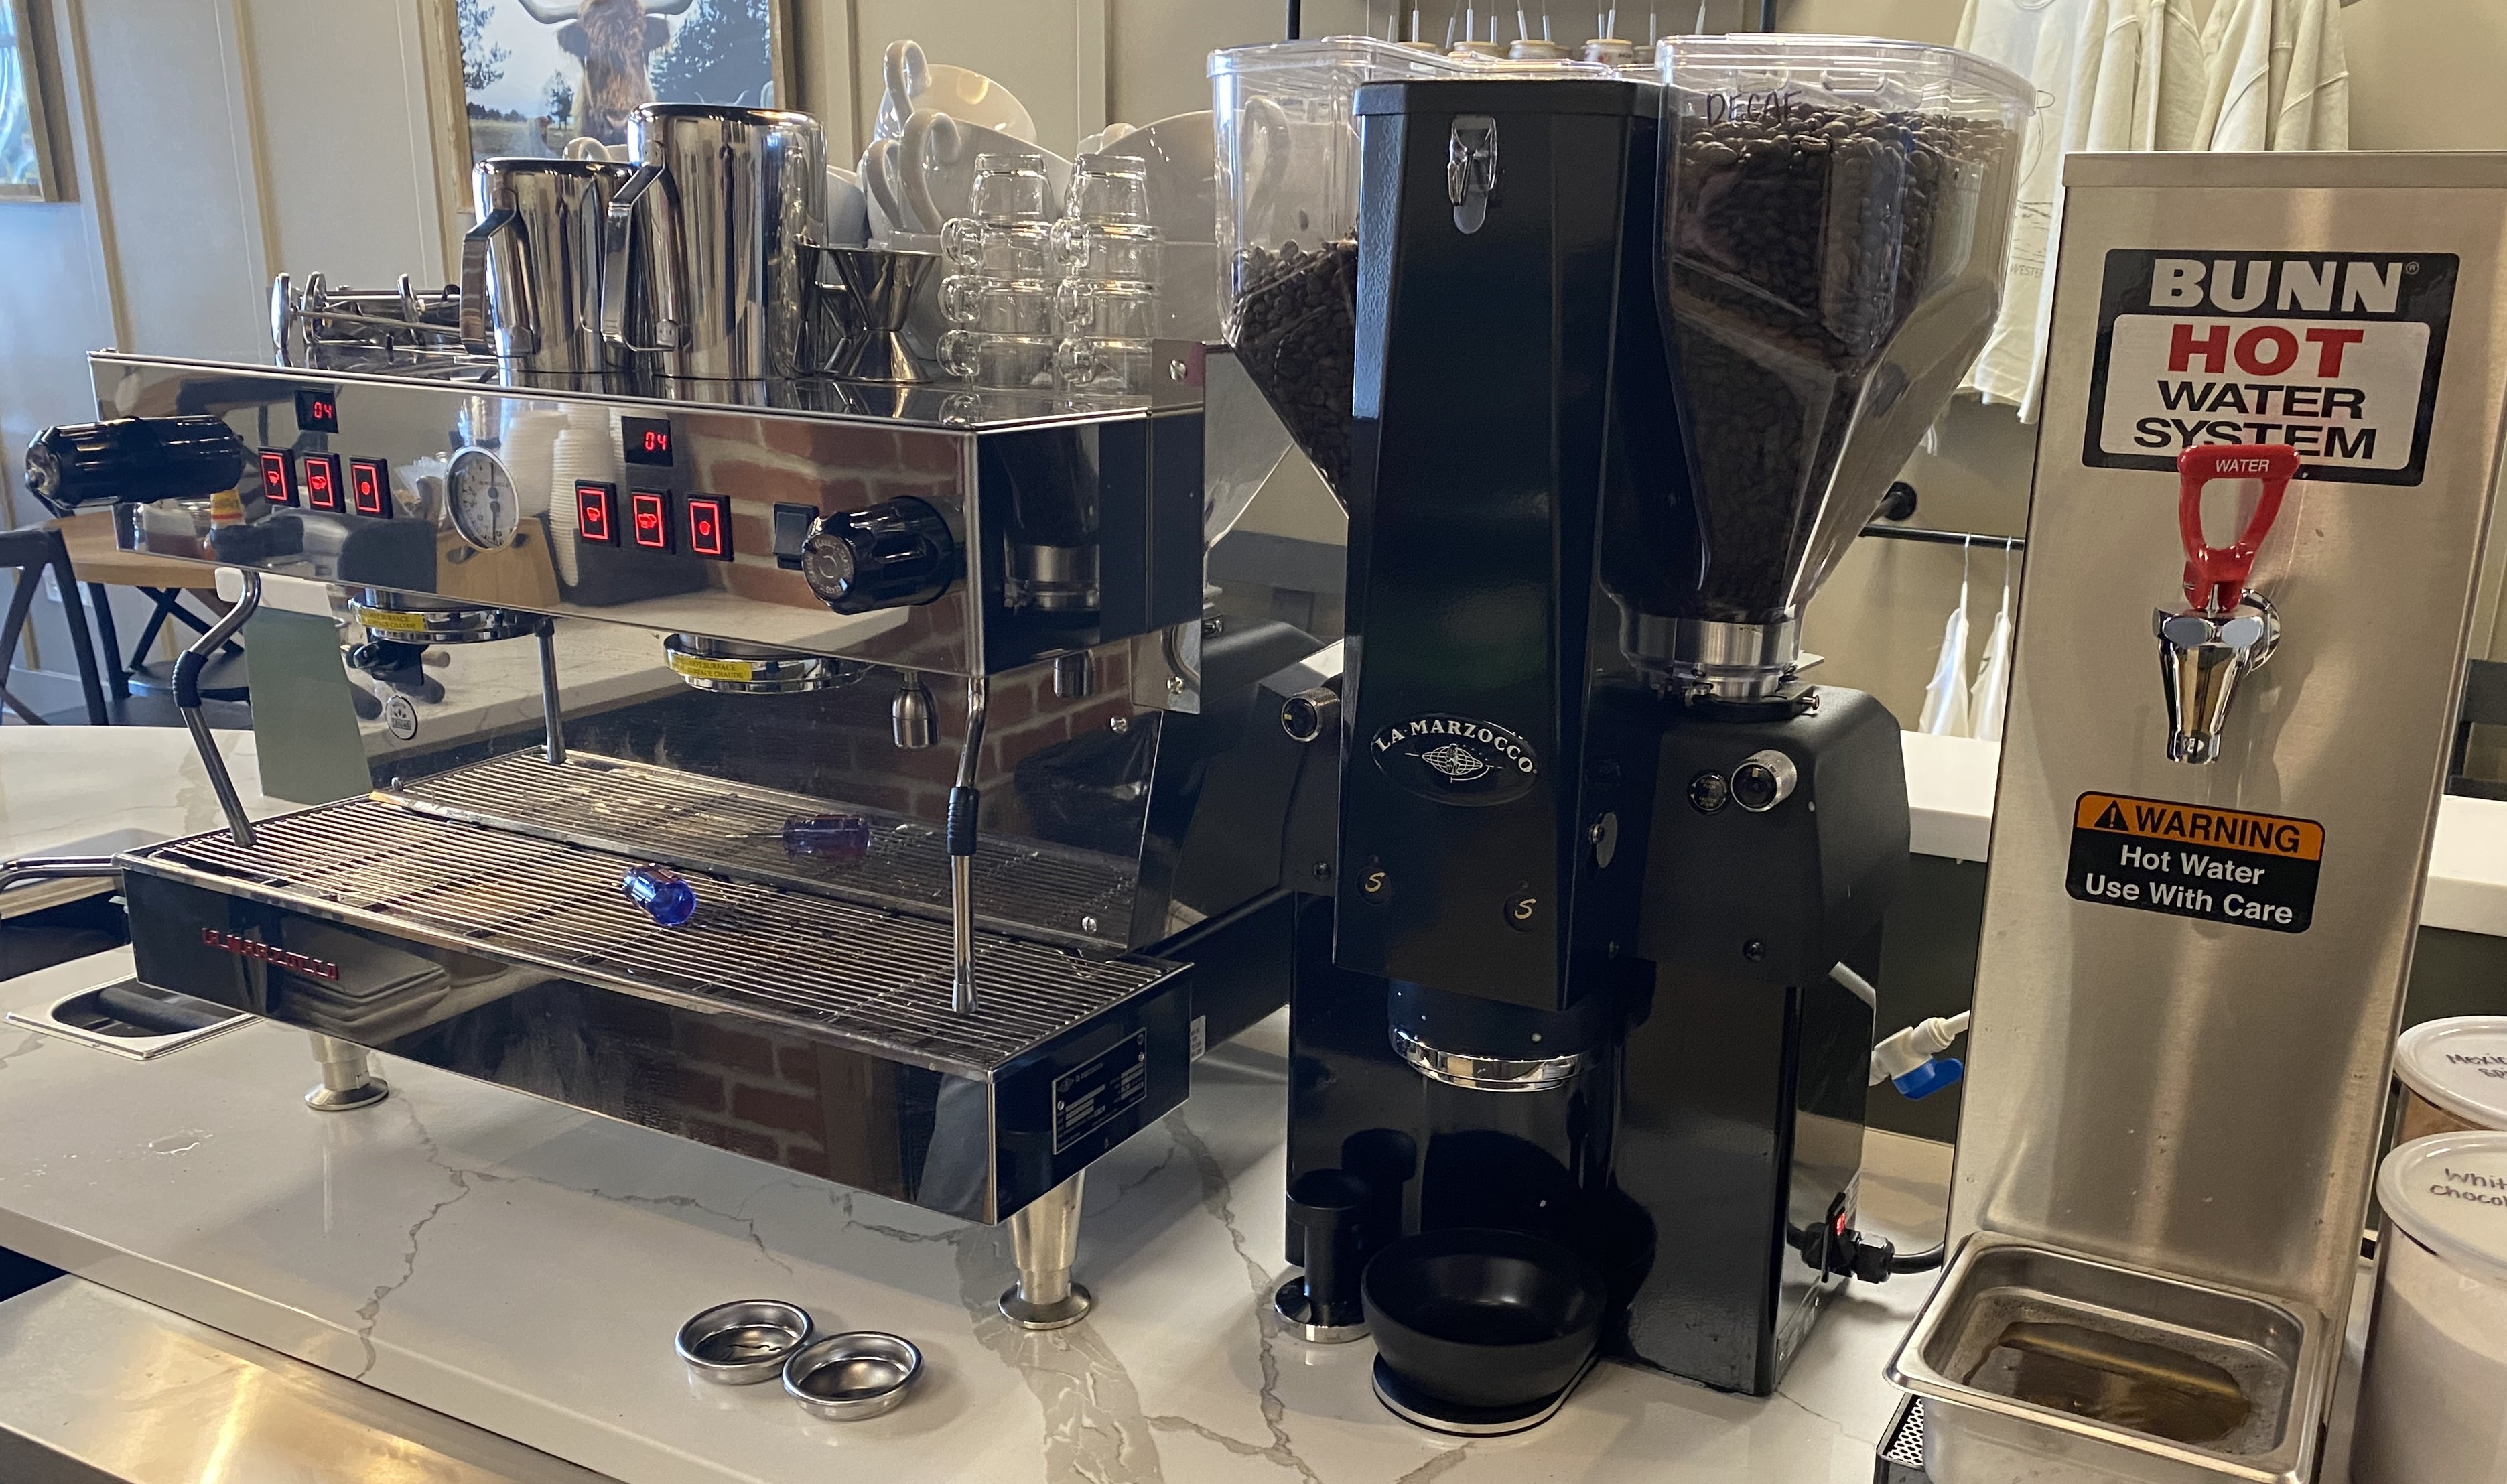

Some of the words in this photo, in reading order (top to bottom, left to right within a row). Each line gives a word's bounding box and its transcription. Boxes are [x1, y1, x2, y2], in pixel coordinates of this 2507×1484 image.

[1706, 90, 1802, 126] DECAF
[2149, 258, 2403, 313] BUNN
[2167, 324, 2364, 378] HOT
[312, 401, 332, 420] 04
[2157, 380, 2366, 419] WATER
[644, 430, 667, 451] 04
[2133, 417, 2378, 460] SYSTEM
[2215, 458, 2270, 473] WATER
[1375, 727, 1406, 752] LA
[1410, 719, 1533, 773] MARZOCCO
[2135, 805, 2300, 854] WARNING
[2120, 844, 2171, 872] Hot
[2181, 852, 2265, 885] Water
[2086, 872, 2139, 901] Use
[2149, 881, 2212, 913] With
[2223, 893, 2293, 925] Care
